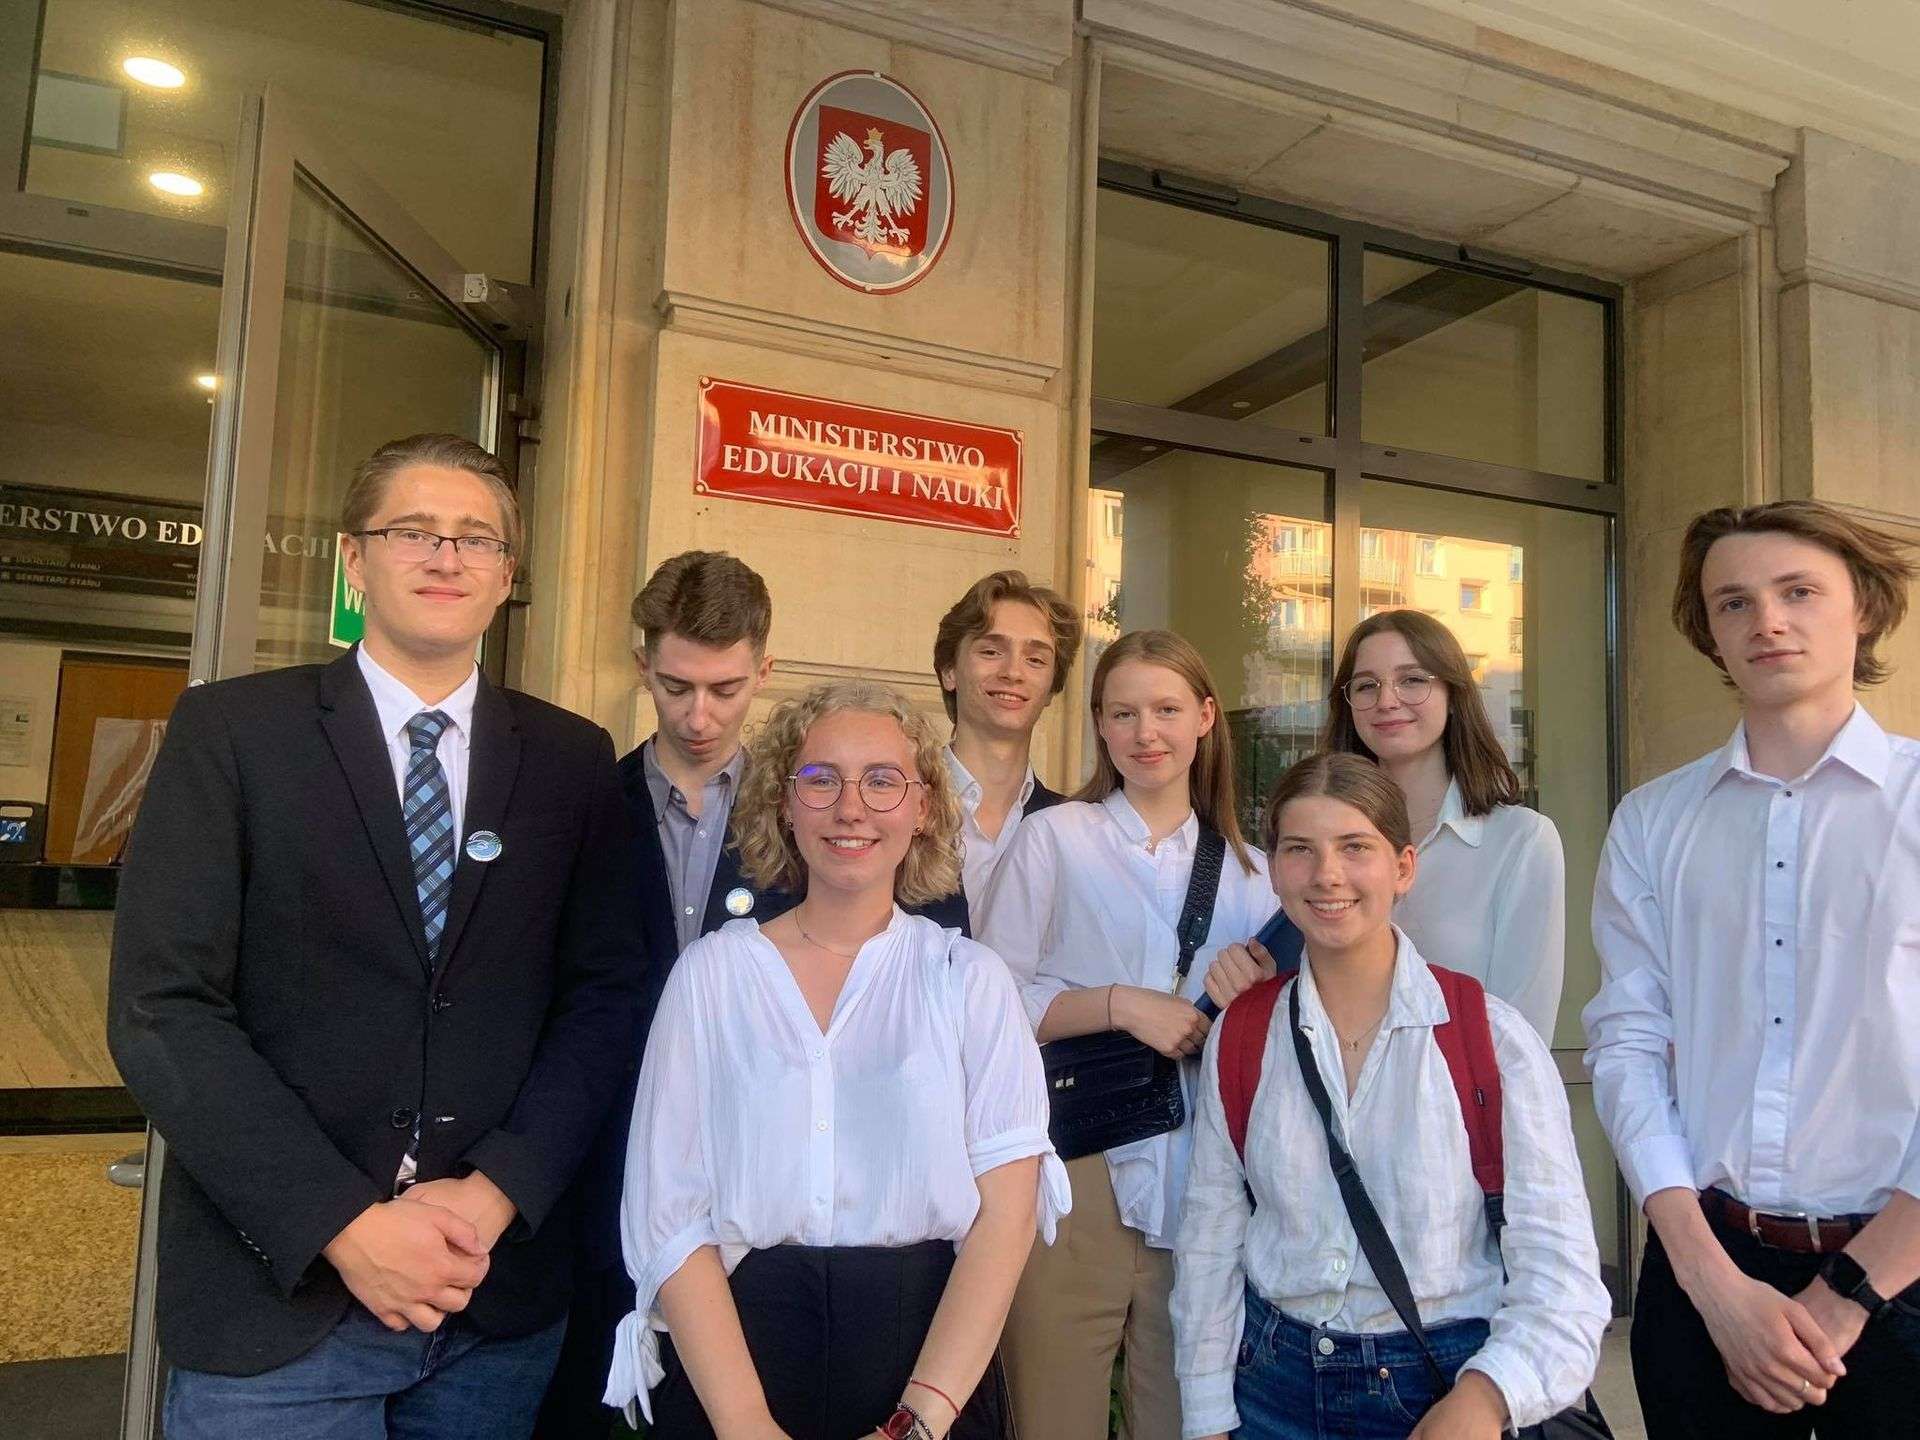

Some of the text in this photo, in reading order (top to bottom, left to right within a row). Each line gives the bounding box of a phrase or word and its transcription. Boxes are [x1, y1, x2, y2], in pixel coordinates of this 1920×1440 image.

[749, 410, 985, 469] MINISTERSTWO
[721, 444, 1003, 511] EDUKACJI I NAUKI
[0, 503, 147, 540] ERSTWO
